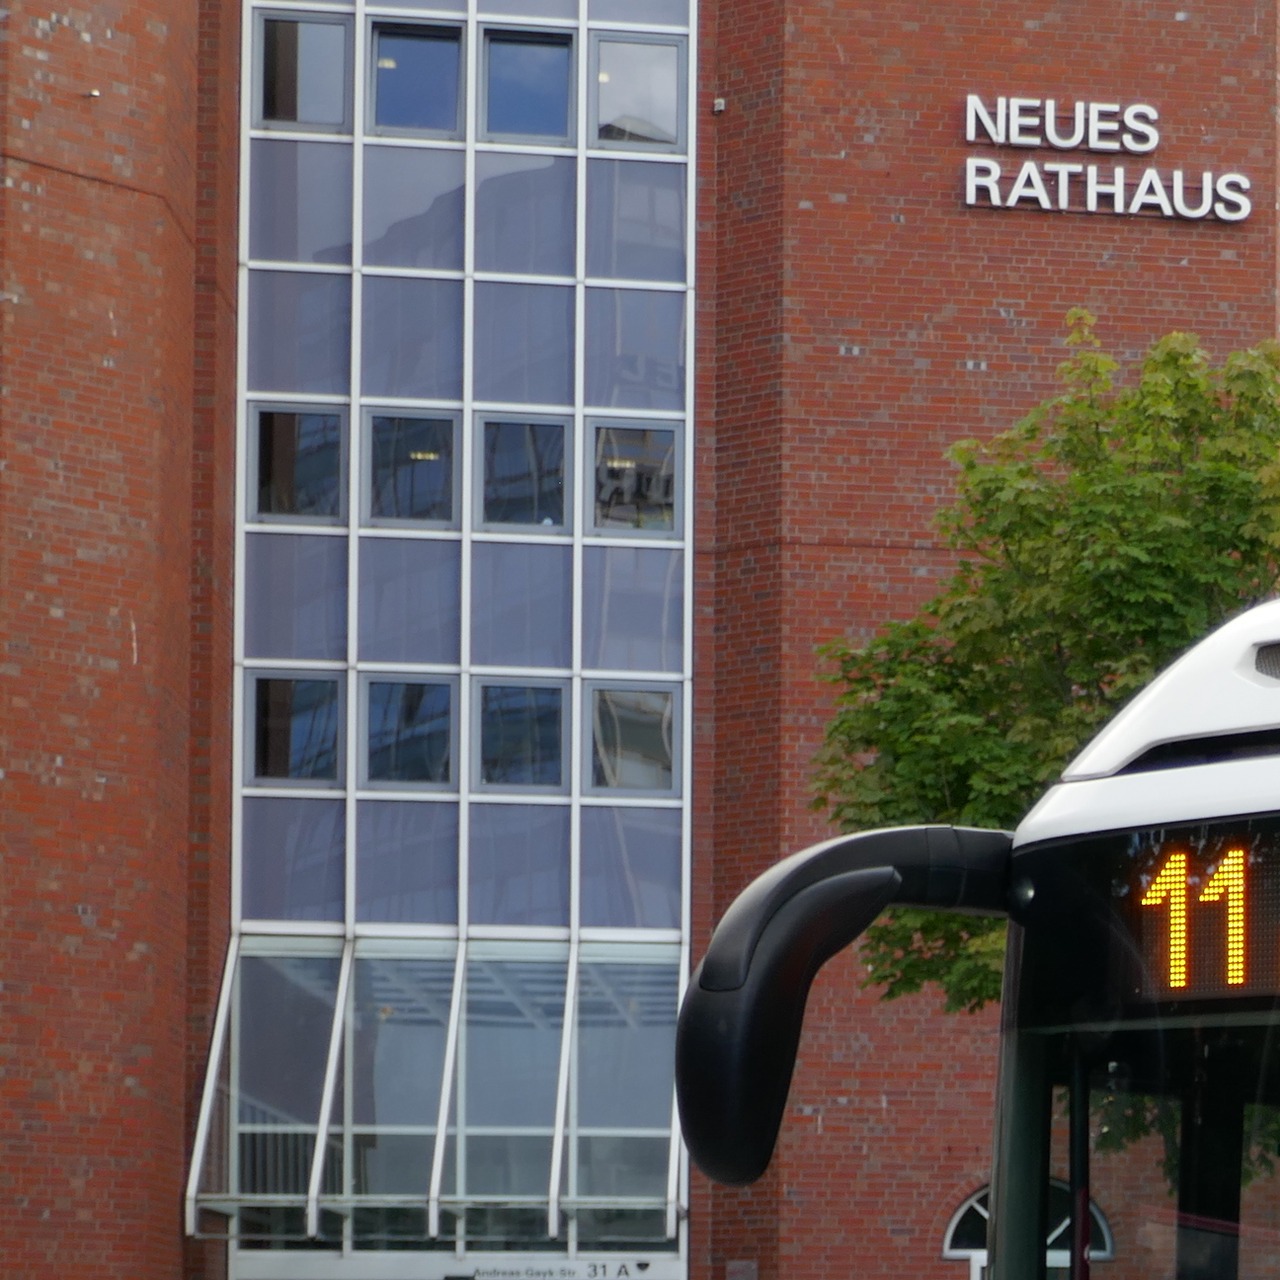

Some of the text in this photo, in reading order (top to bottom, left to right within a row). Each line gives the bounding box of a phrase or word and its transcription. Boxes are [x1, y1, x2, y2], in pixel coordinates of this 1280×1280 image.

[965, 94, 1160, 152] NEUES
[965, 157, 1252, 221] RATHAUS
[1140, 849, 1246, 988] 11
[587, 1263, 607, 1279] 31
[617, 1264, 630, 1278] A
